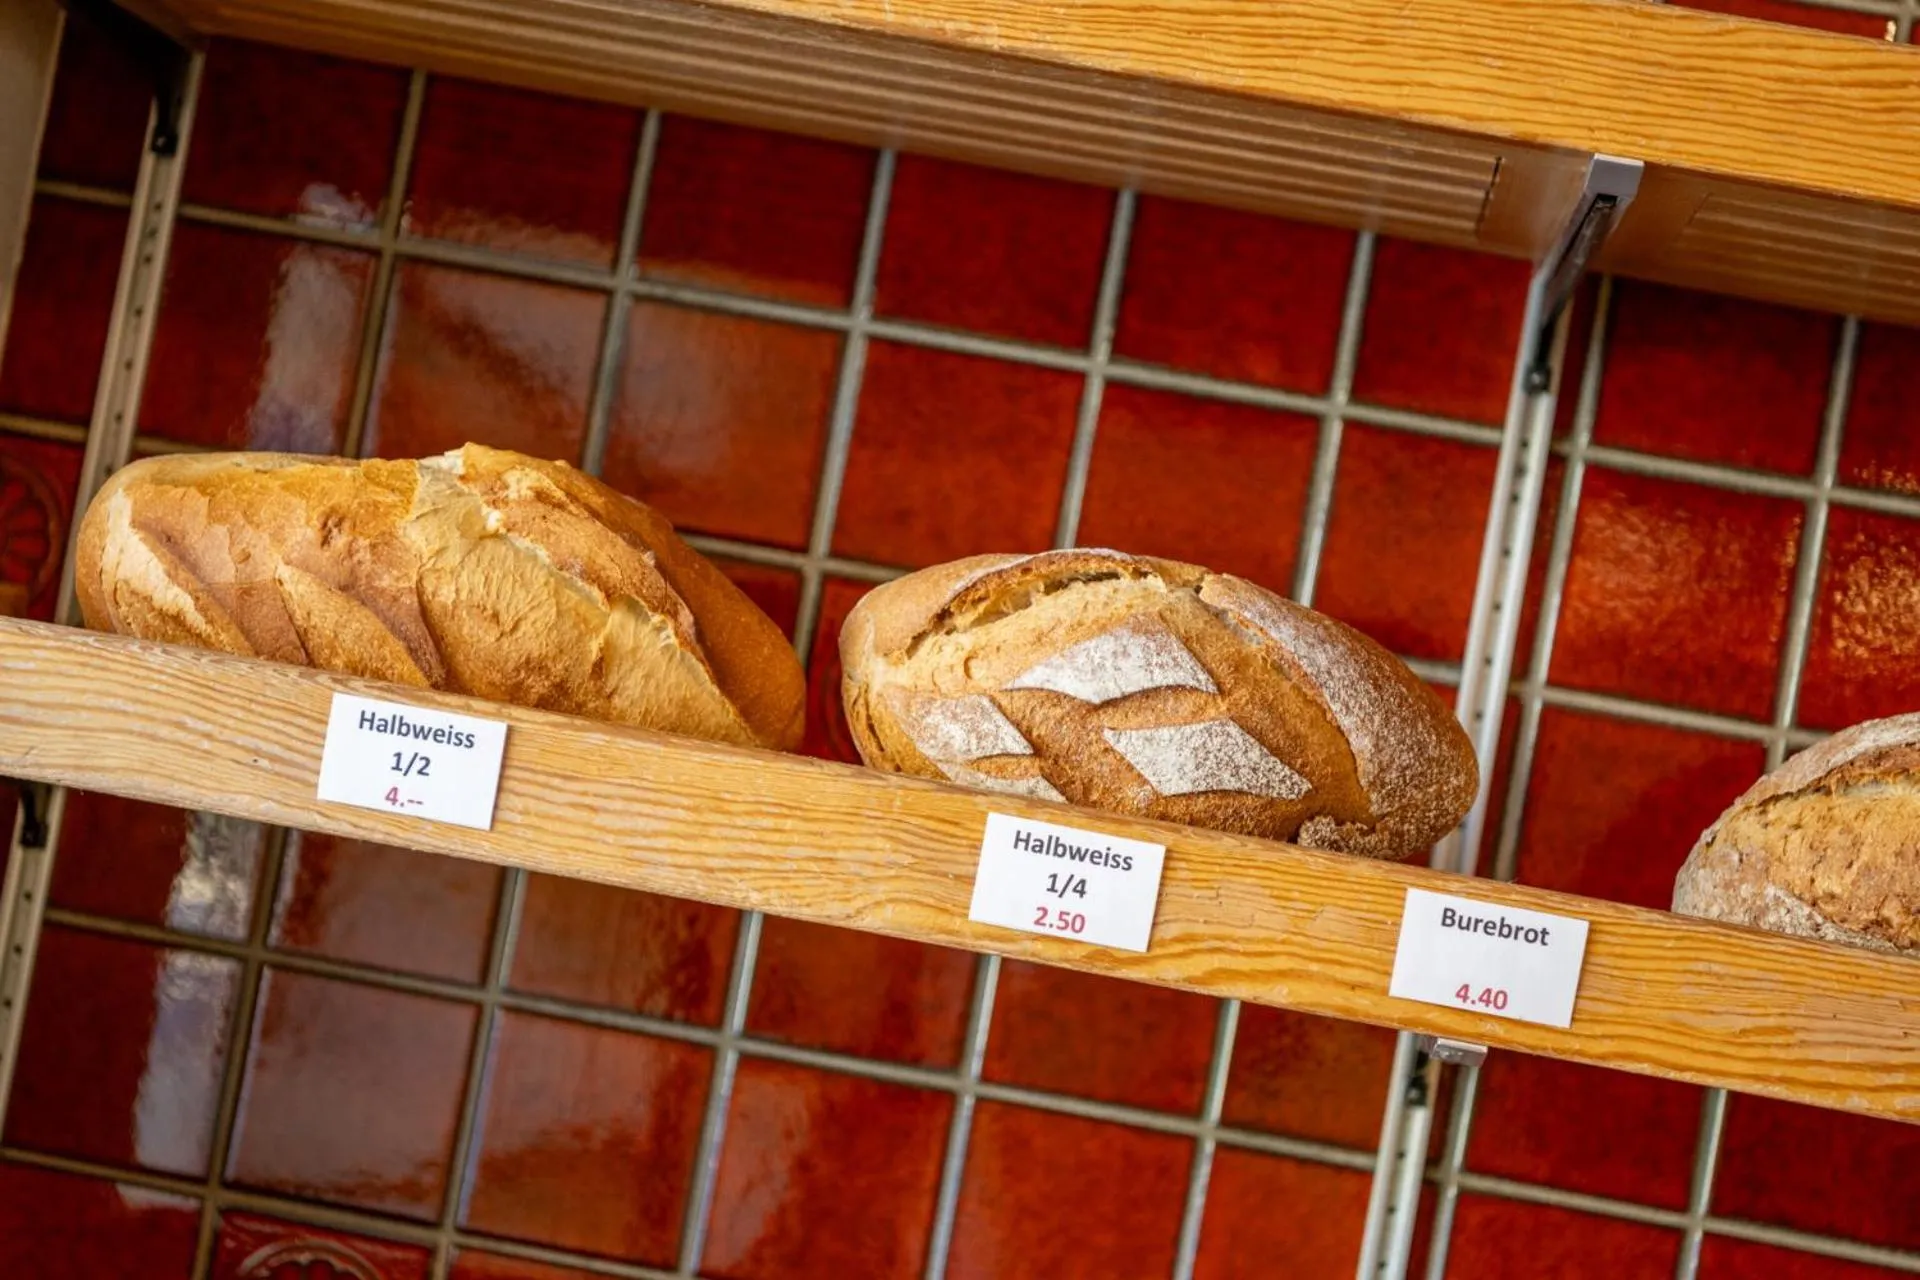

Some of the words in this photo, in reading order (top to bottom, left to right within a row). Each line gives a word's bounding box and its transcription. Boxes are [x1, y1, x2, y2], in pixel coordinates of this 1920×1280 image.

[358, 709, 476, 750] Halbweiss
[390, 751, 432, 777] 1/2
[1013, 829, 1133, 872] Halbweiss
[1045, 872, 1087, 899] 1/4
[1034, 905, 1086, 935] 2.50
[1440, 906, 1551, 947] Burebrot
[1454, 982, 1509, 1011] 4.40
